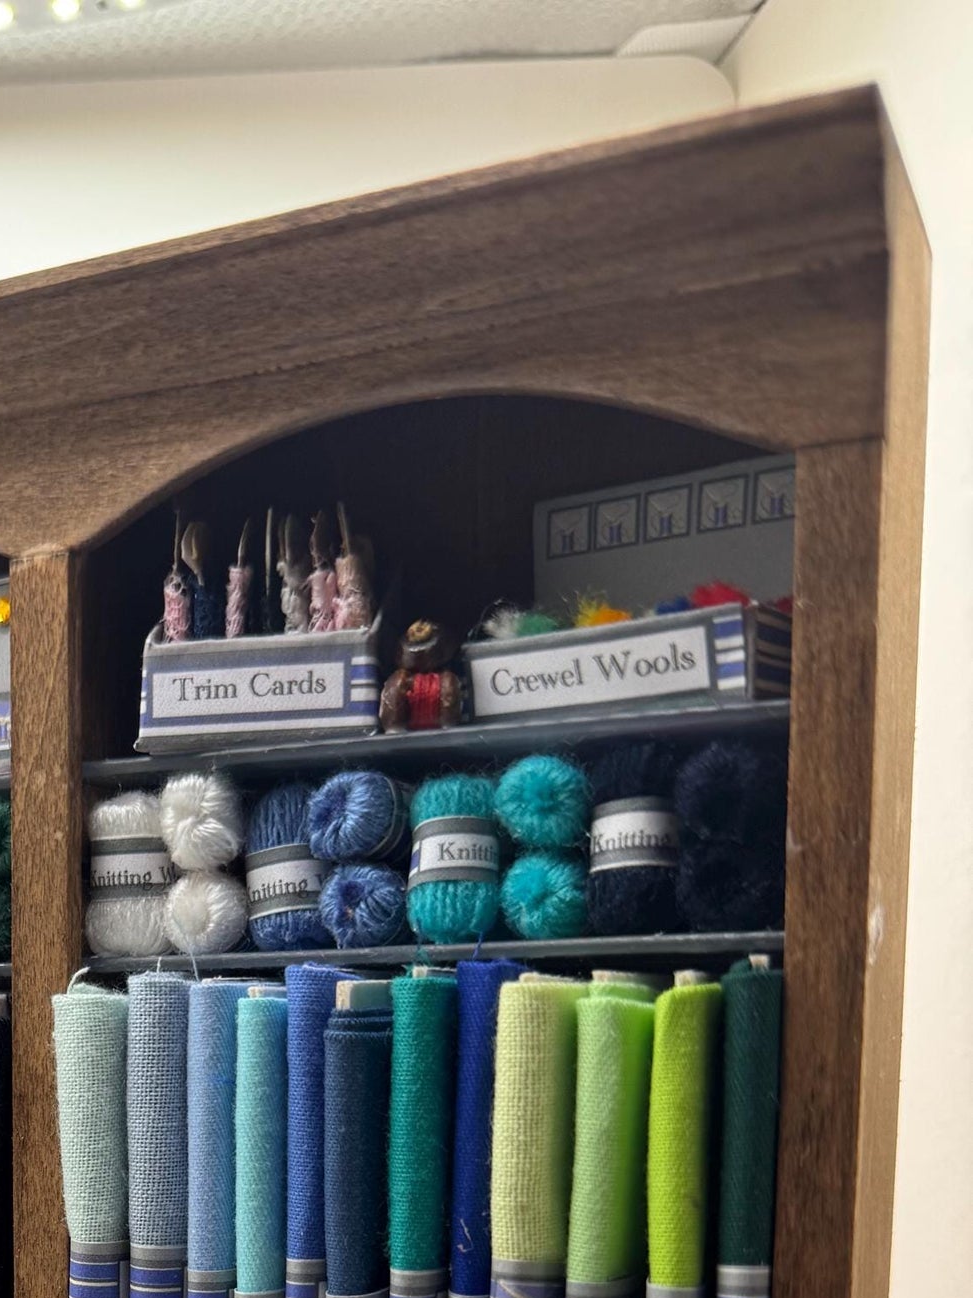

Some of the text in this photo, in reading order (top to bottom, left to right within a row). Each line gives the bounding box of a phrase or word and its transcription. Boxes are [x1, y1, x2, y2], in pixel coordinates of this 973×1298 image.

[172, 670, 327, 701] Trim Cards
[490, 641, 697, 697] Crewel Wools
